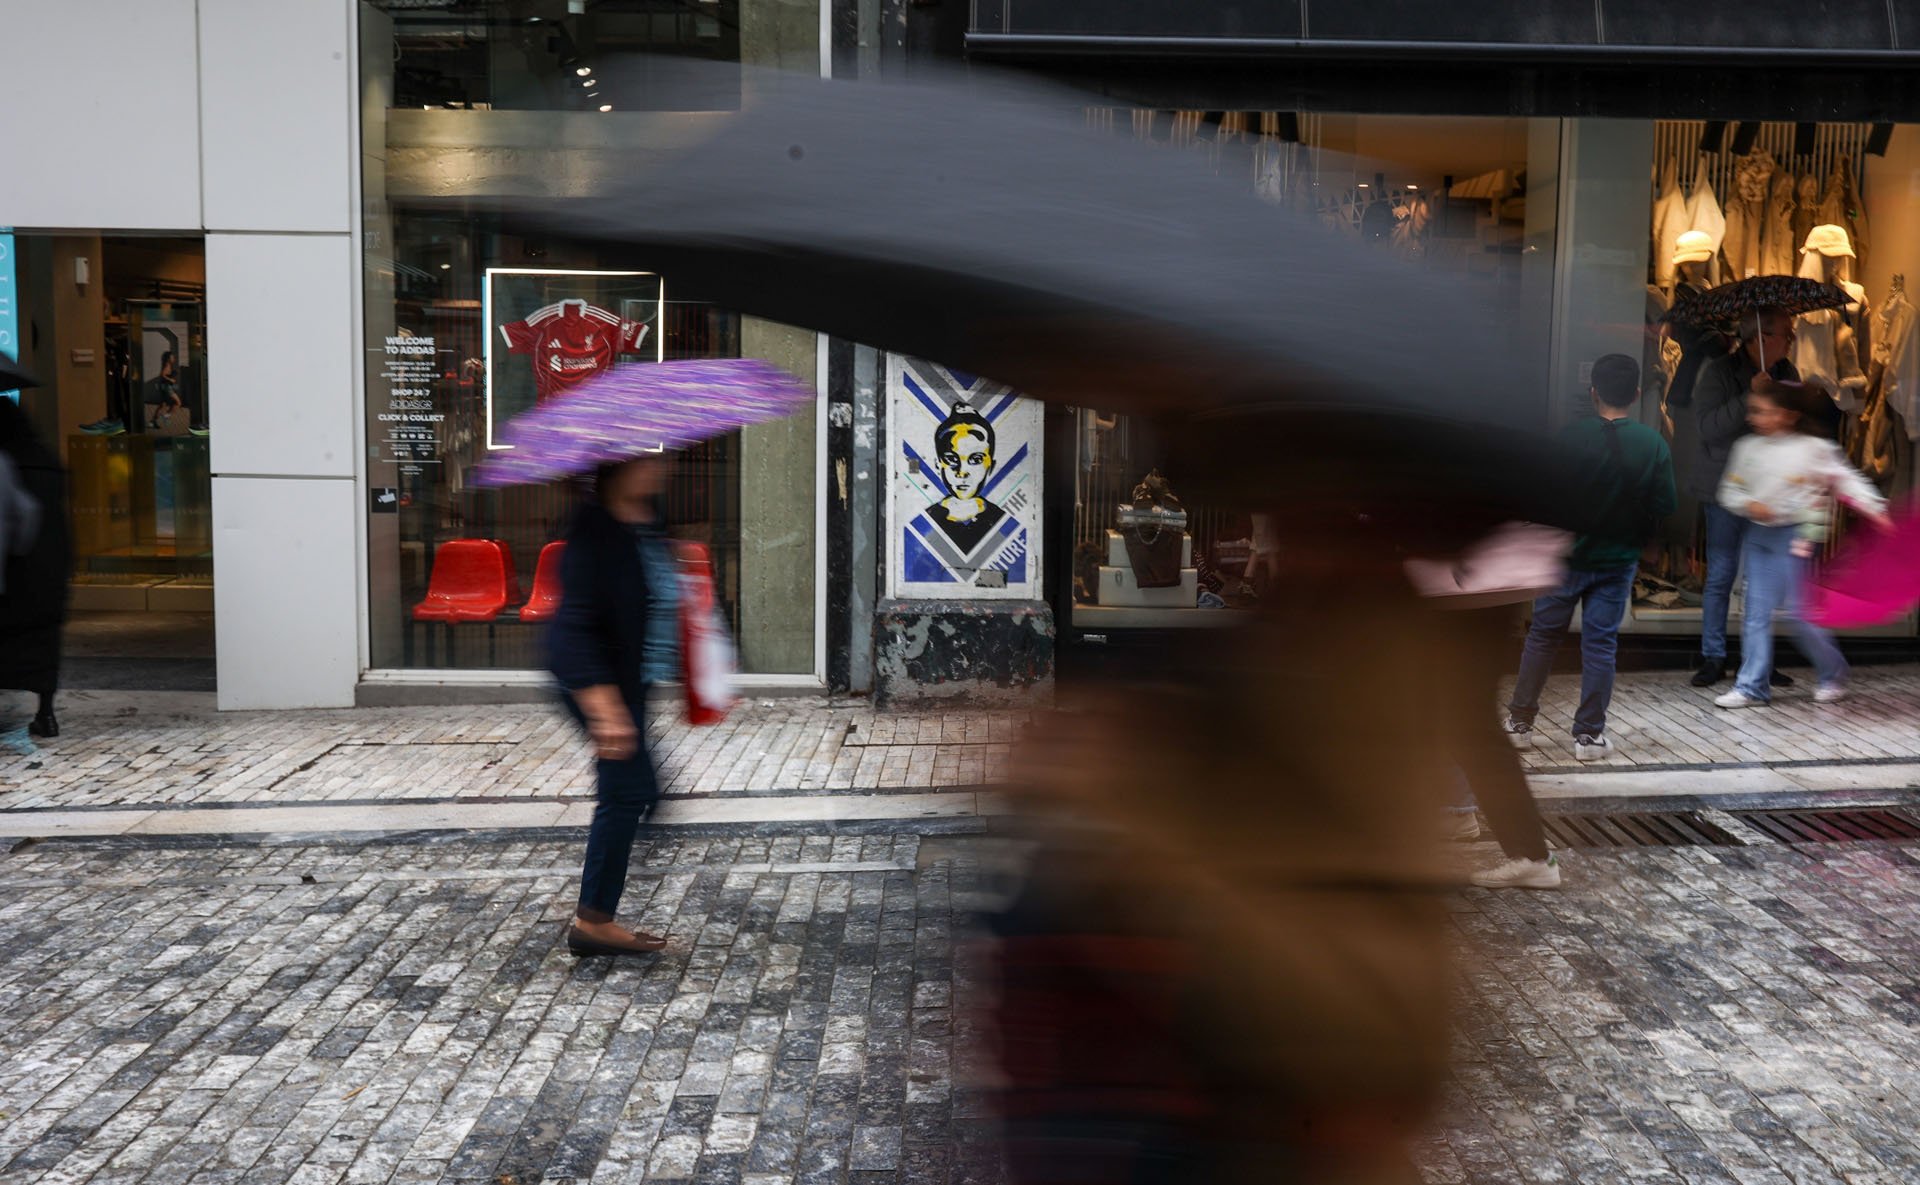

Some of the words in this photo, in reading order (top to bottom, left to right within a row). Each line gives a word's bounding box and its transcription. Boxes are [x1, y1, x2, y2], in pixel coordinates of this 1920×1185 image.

[385, 336, 434, 345] WELCOME
[385, 346, 399, 354] TO
[400, 346, 436, 355] ADIDAS
[391, 388, 413, 397] SHOP
